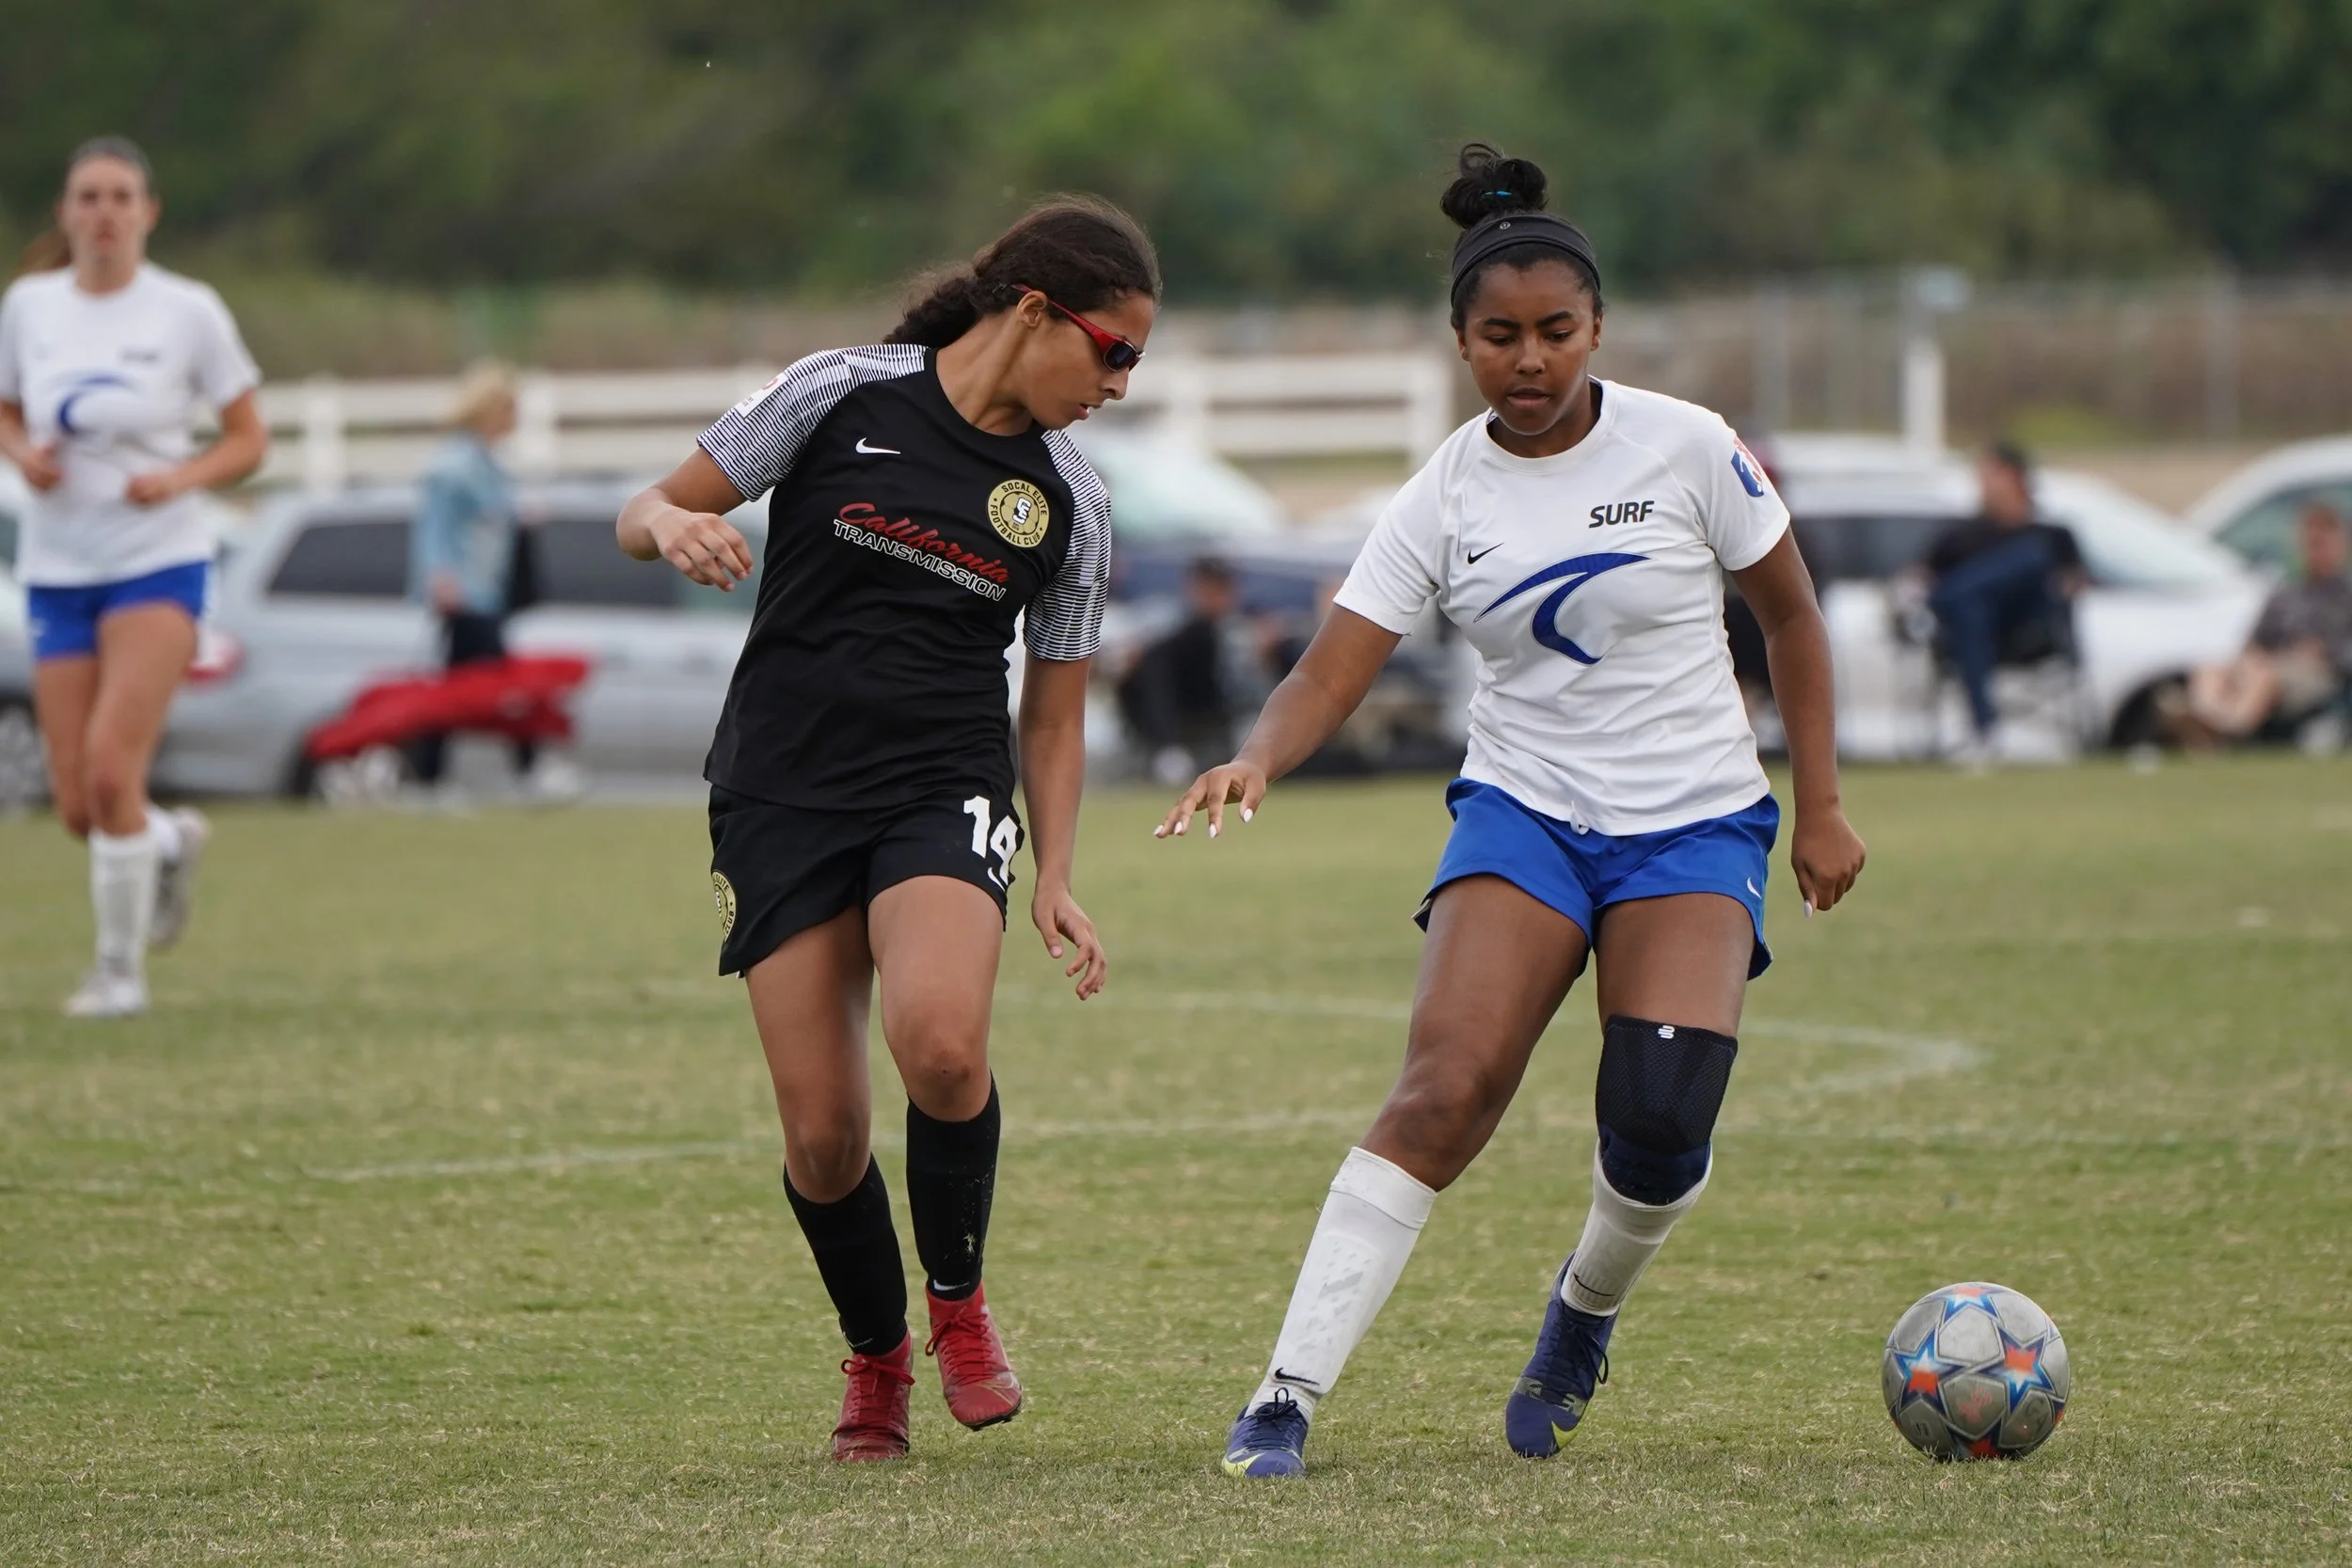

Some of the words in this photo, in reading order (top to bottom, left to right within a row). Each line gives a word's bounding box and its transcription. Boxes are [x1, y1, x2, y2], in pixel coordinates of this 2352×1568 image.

[1001, 482, 1030, 493] SOCAL
[1032, 490, 1047, 515] ELITE
[1588, 500, 1655, 529] SURF
[839, 502, 1009, 583] California
[990, 504, 1022, 545] FOOTBALL
[1024, 532, 1041, 546] CLUB
[833, 519, 1007, 601] TRANSMISSION
